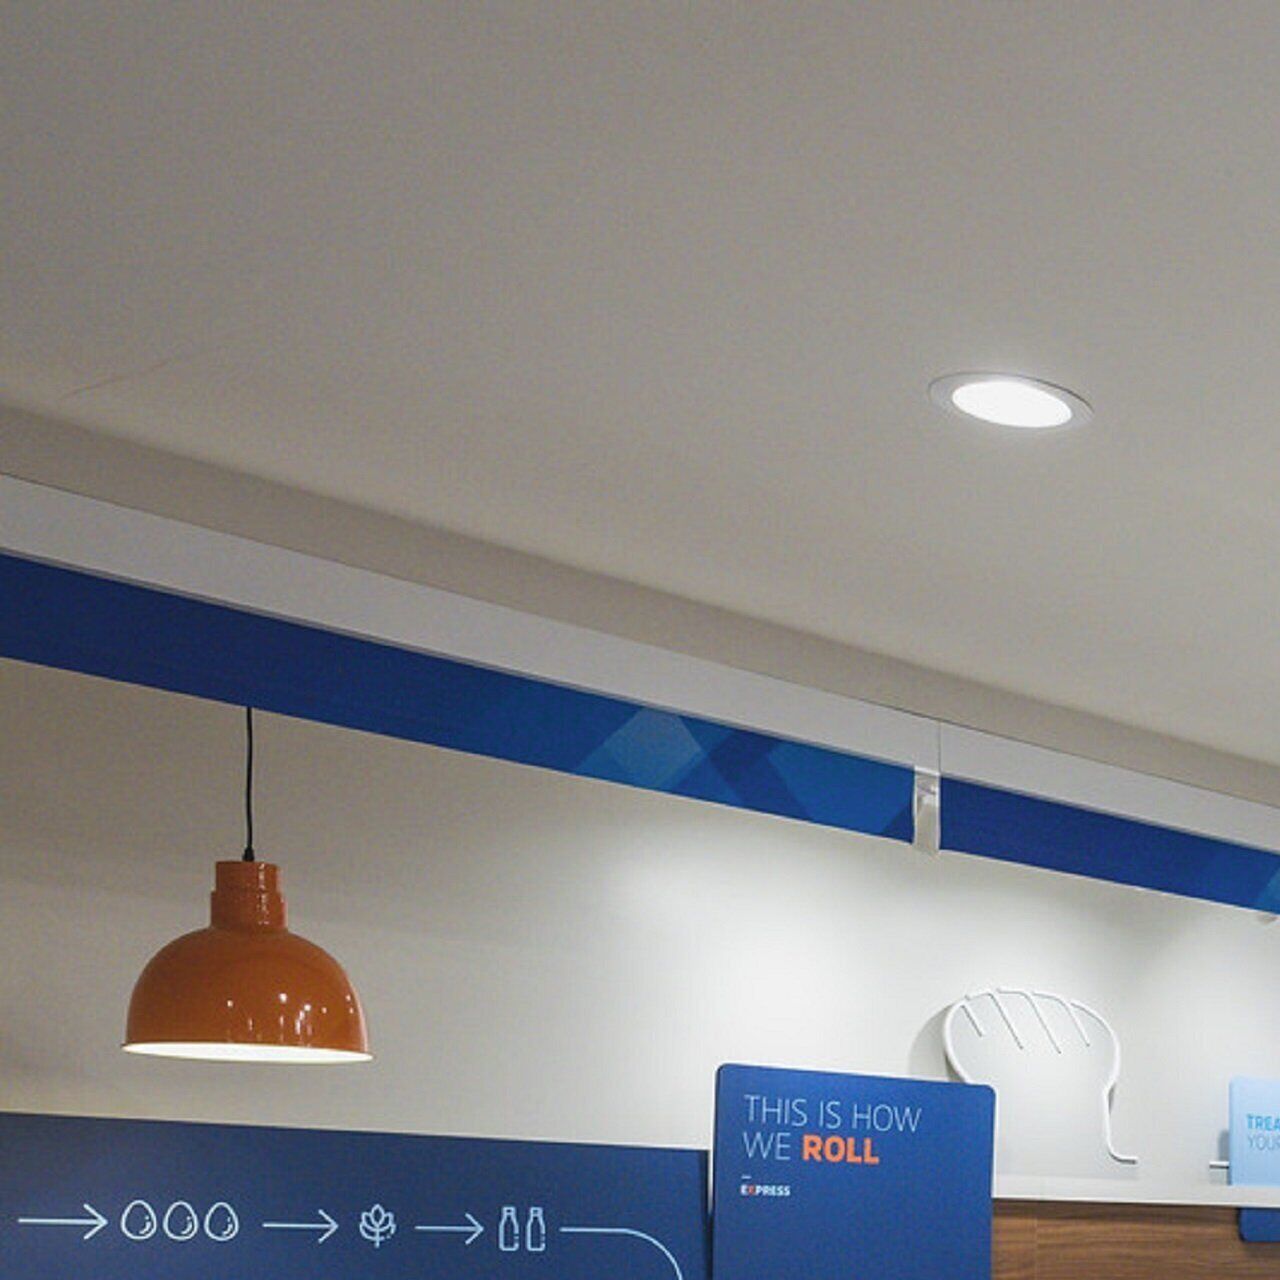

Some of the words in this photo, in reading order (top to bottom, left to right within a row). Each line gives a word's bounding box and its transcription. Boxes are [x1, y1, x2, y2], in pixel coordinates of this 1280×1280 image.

[744, 1094, 808, 1127] THIS
[819, 1100, 842, 1129] IS
[852, 1103, 922, 1133] HOW
[743, 1131, 791, 1161] WE
[802, 1134, 880, 1165] ROLL
[740, 1184, 791, 1196] EXPRESS
